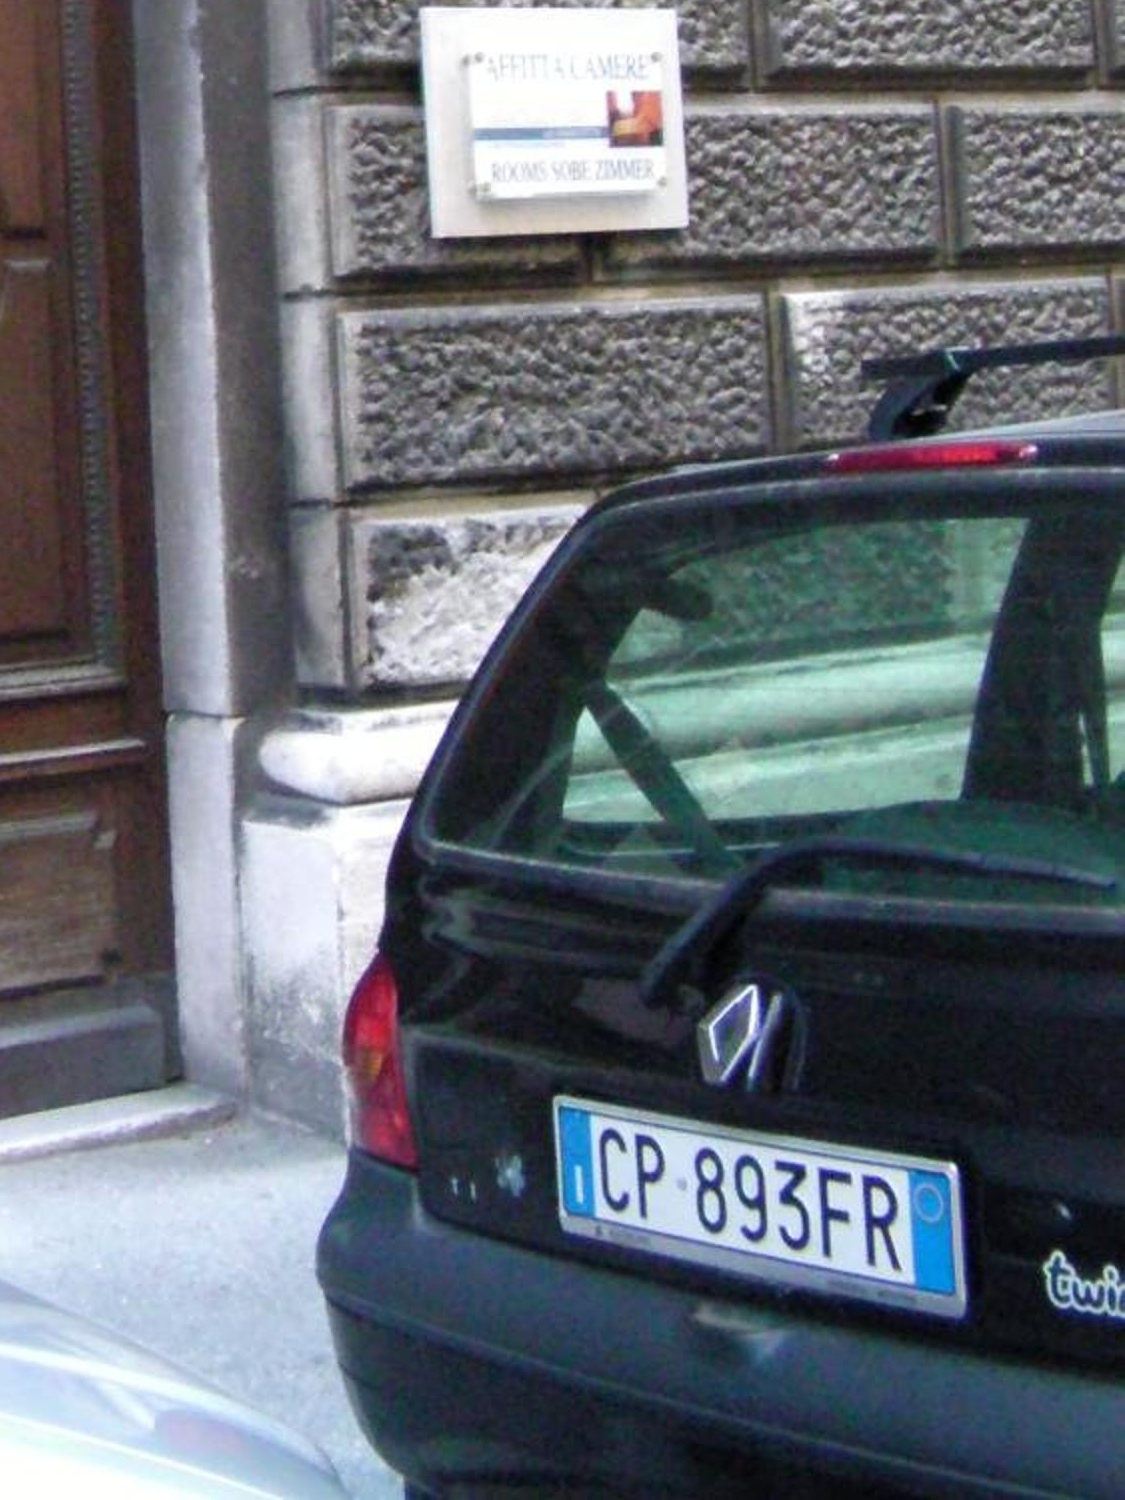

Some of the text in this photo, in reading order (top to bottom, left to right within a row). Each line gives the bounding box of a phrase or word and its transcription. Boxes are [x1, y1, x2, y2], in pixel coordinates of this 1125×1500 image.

[570, 52, 650, 82] CAMERE
[490, 157, 655, 183] ROOMS SOBE ZIMMER
[599, 1127, 902, 1272] CP 893FR
